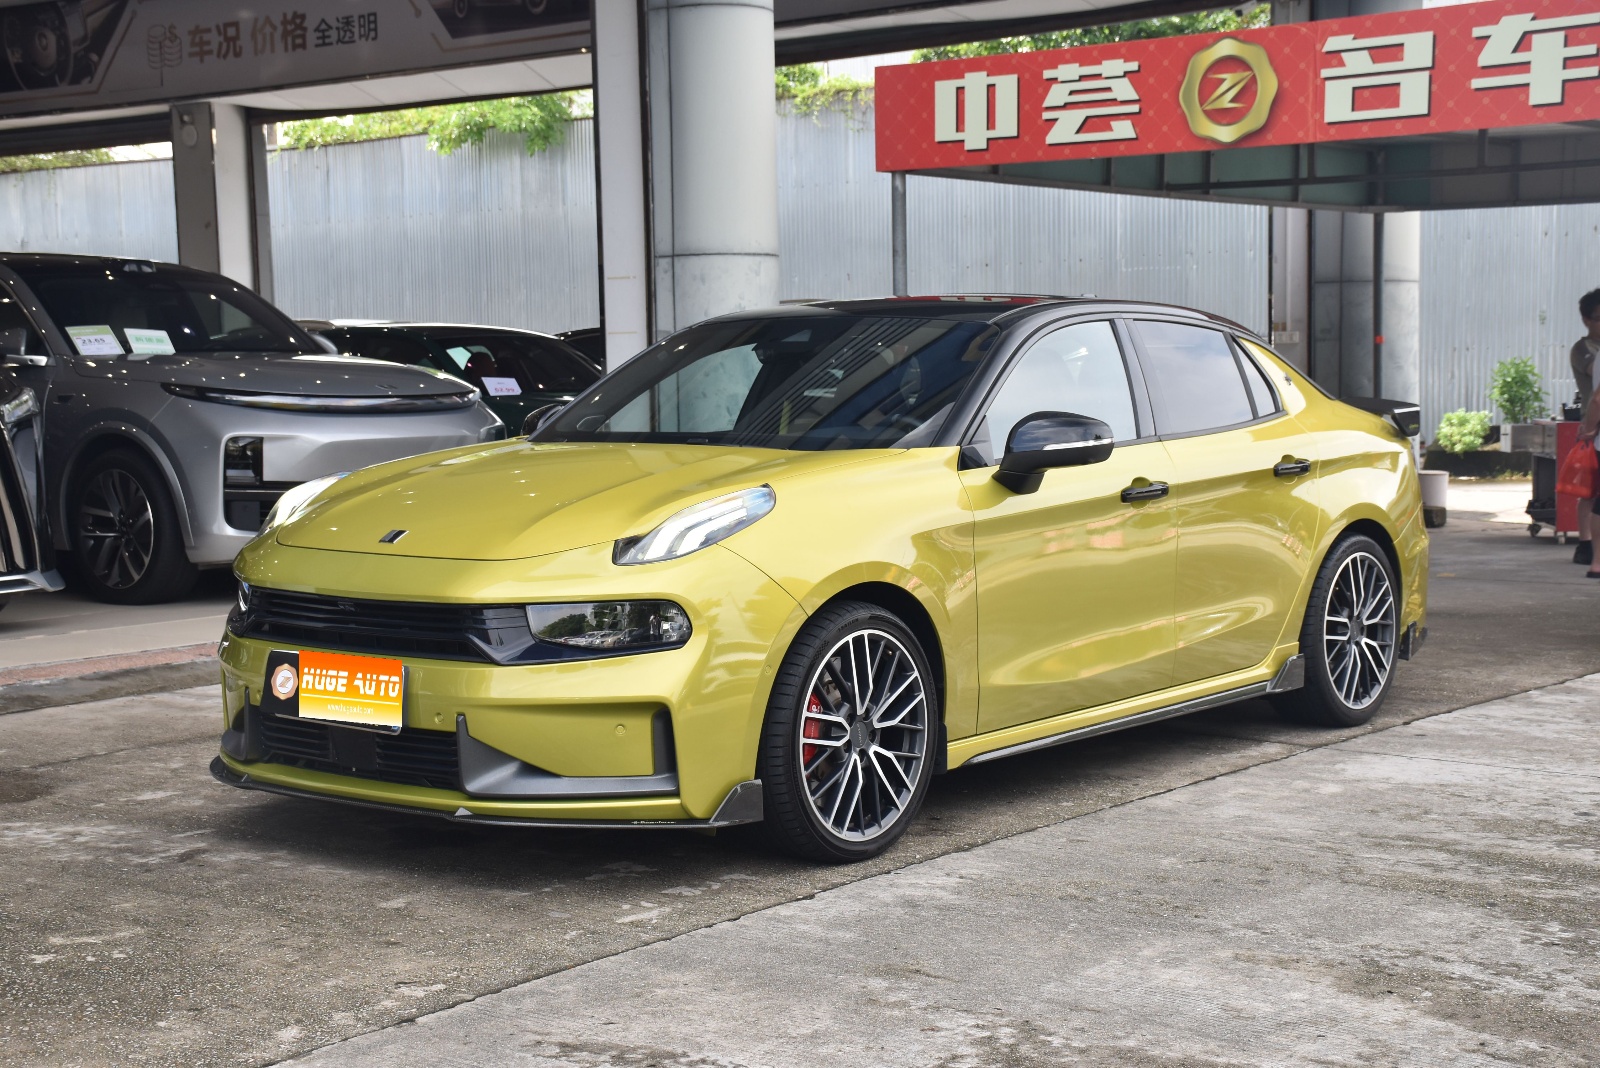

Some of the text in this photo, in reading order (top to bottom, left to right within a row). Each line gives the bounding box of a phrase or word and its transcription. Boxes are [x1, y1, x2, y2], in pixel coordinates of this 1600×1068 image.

[187, 10, 378, 64] 车况 价格 全透明
[1320, 12, 1600, 123] 名车
[935, 59, 1140, 150] 中荟
